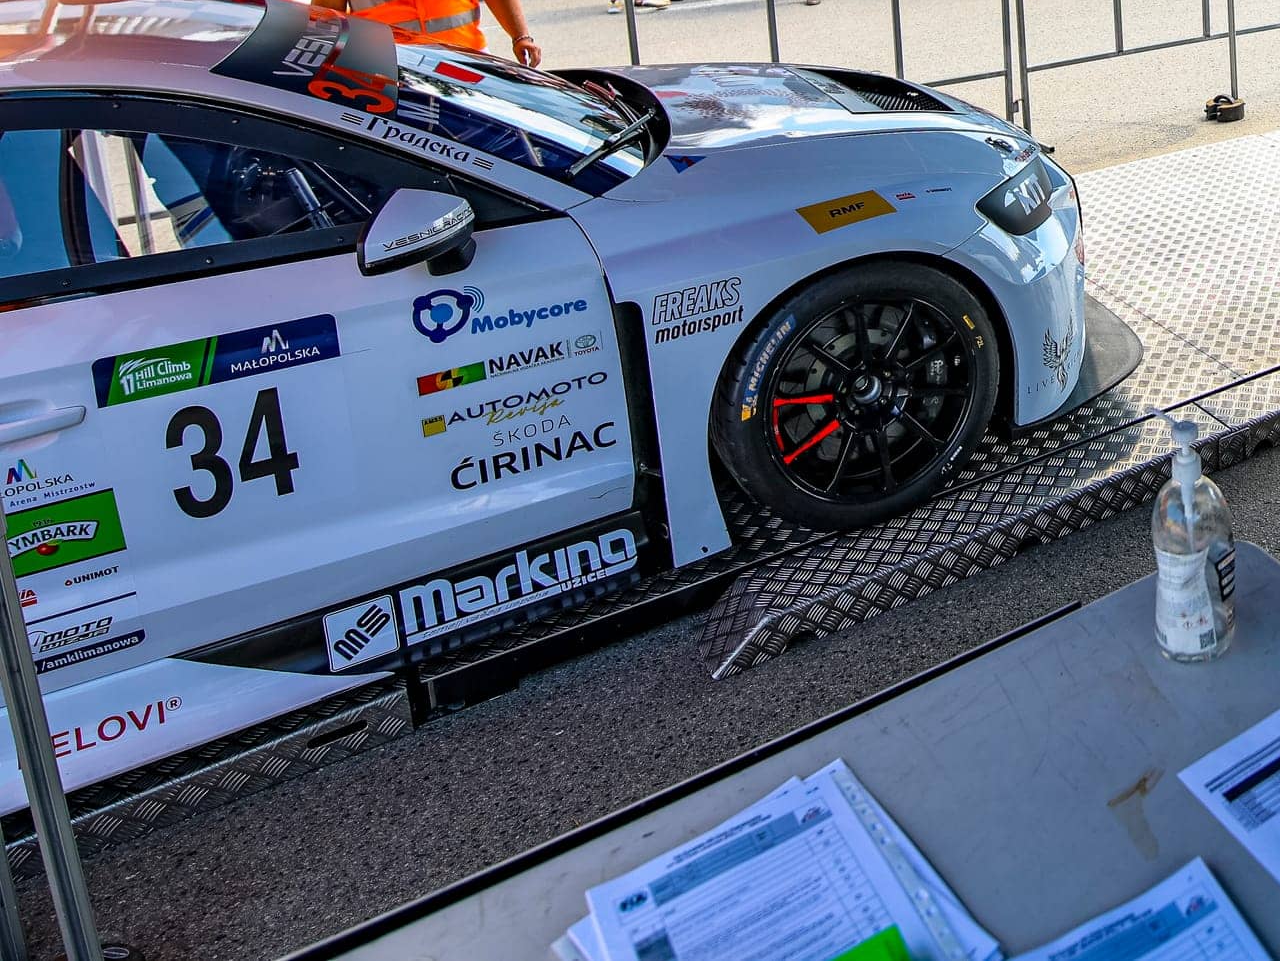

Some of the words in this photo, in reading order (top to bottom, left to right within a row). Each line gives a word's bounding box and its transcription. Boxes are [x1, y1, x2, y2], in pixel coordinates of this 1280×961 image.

[366, 116, 470, 163] Градска
[829, 201, 865, 219] RMF
[651, 277, 742, 326] FREAKS
[471, 299, 588, 335] Mobycore
[655, 305, 744, 344] motorsport
[231, 346, 321, 374] MAŁOPOLSKA
[488, 341, 564, 374] NAVAK
[573, 346, 600, 357] TOYOTA
[136, 366, 155, 381] Hill
[157, 360, 191, 377] Climb
[137, 372, 192, 390] Limanowa
[447, 372, 608, 425] AUTOMOTO
[482, 398, 565, 426] Revija
[493, 414, 571, 447] ŠKODA
[166, 387, 300, 519] 34
[451, 421, 617, 490] ĆIRINAC
[10, 496, 37, 507] Arena
[44, 482, 96, 499] Mistrzostw
[8, 524, 92, 551] YMBARK
[73, 566, 120, 584] UNIMOT
[559, 570, 607, 592] UŽICE
